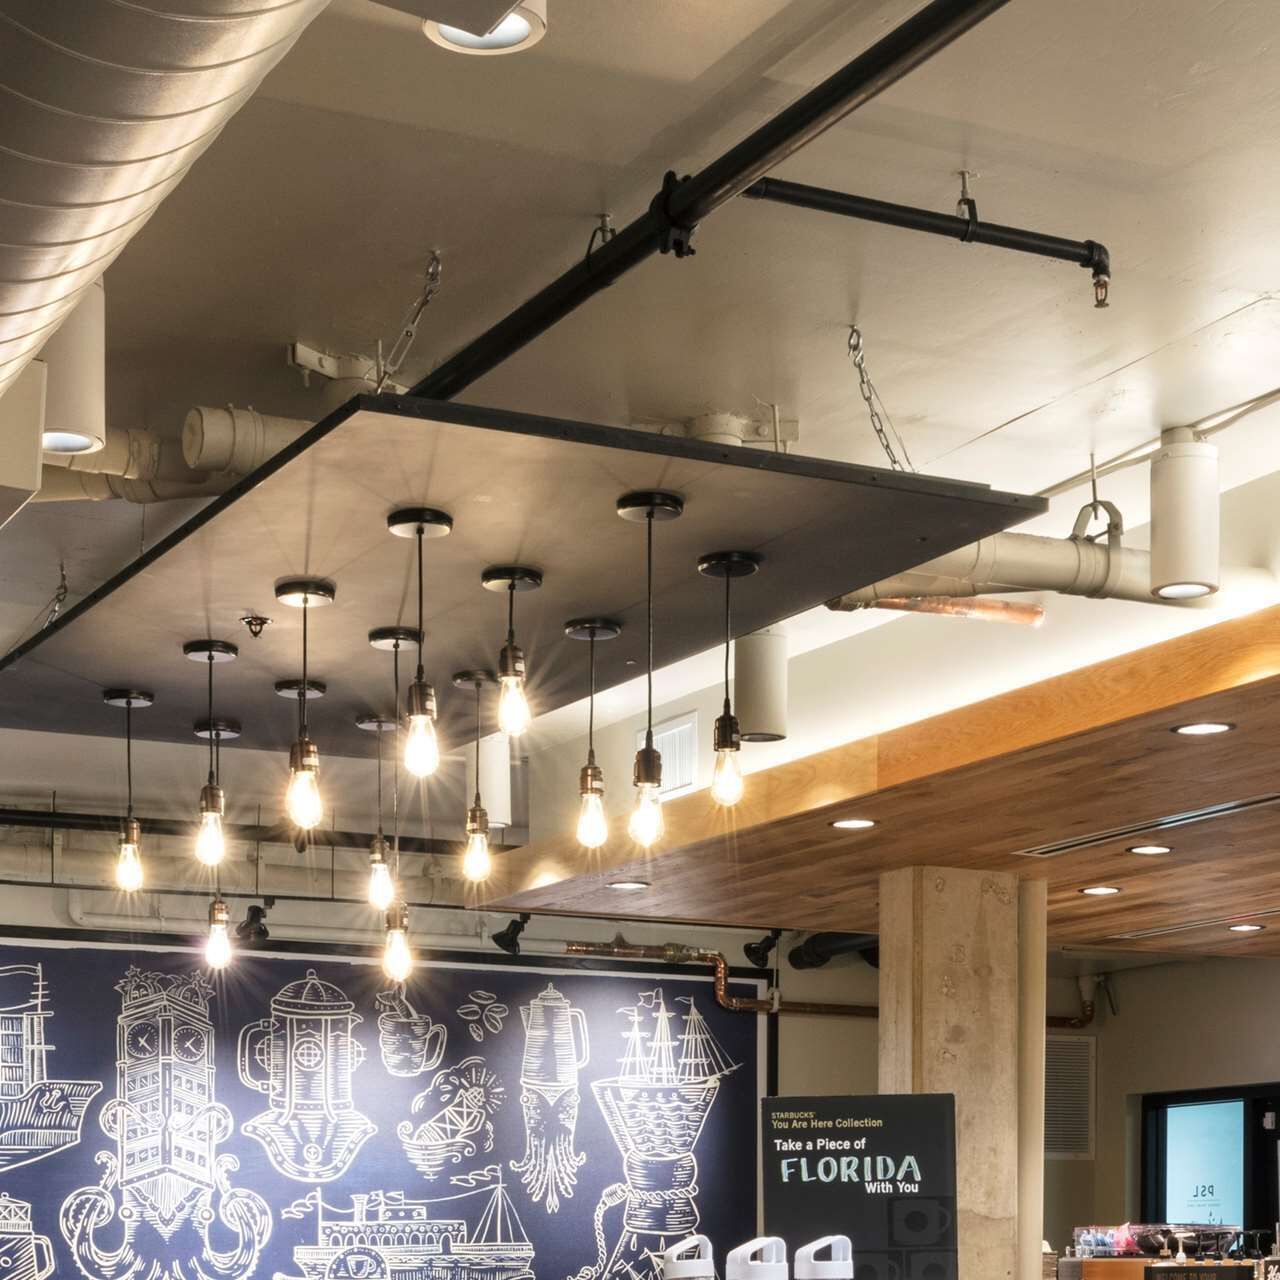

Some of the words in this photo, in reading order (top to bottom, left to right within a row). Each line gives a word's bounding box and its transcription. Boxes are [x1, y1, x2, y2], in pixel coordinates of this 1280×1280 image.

[772, 1119, 789, 1129] You
[791, 1119, 808, 1129] Are
[810, 1119, 833, 1128] Here
[835, 1118, 883, 1128] Collection
[774, 1139, 803, 1151] Take
[805, 1141, 814, 1151] a
[816, 1138, 851, 1151] Piece
[853, 1137, 867, 1150] of
[780, 1155, 922, 1183] FLORIDA
[864, 1181, 893, 1194] With
[896, 1181, 919, 1193] You
